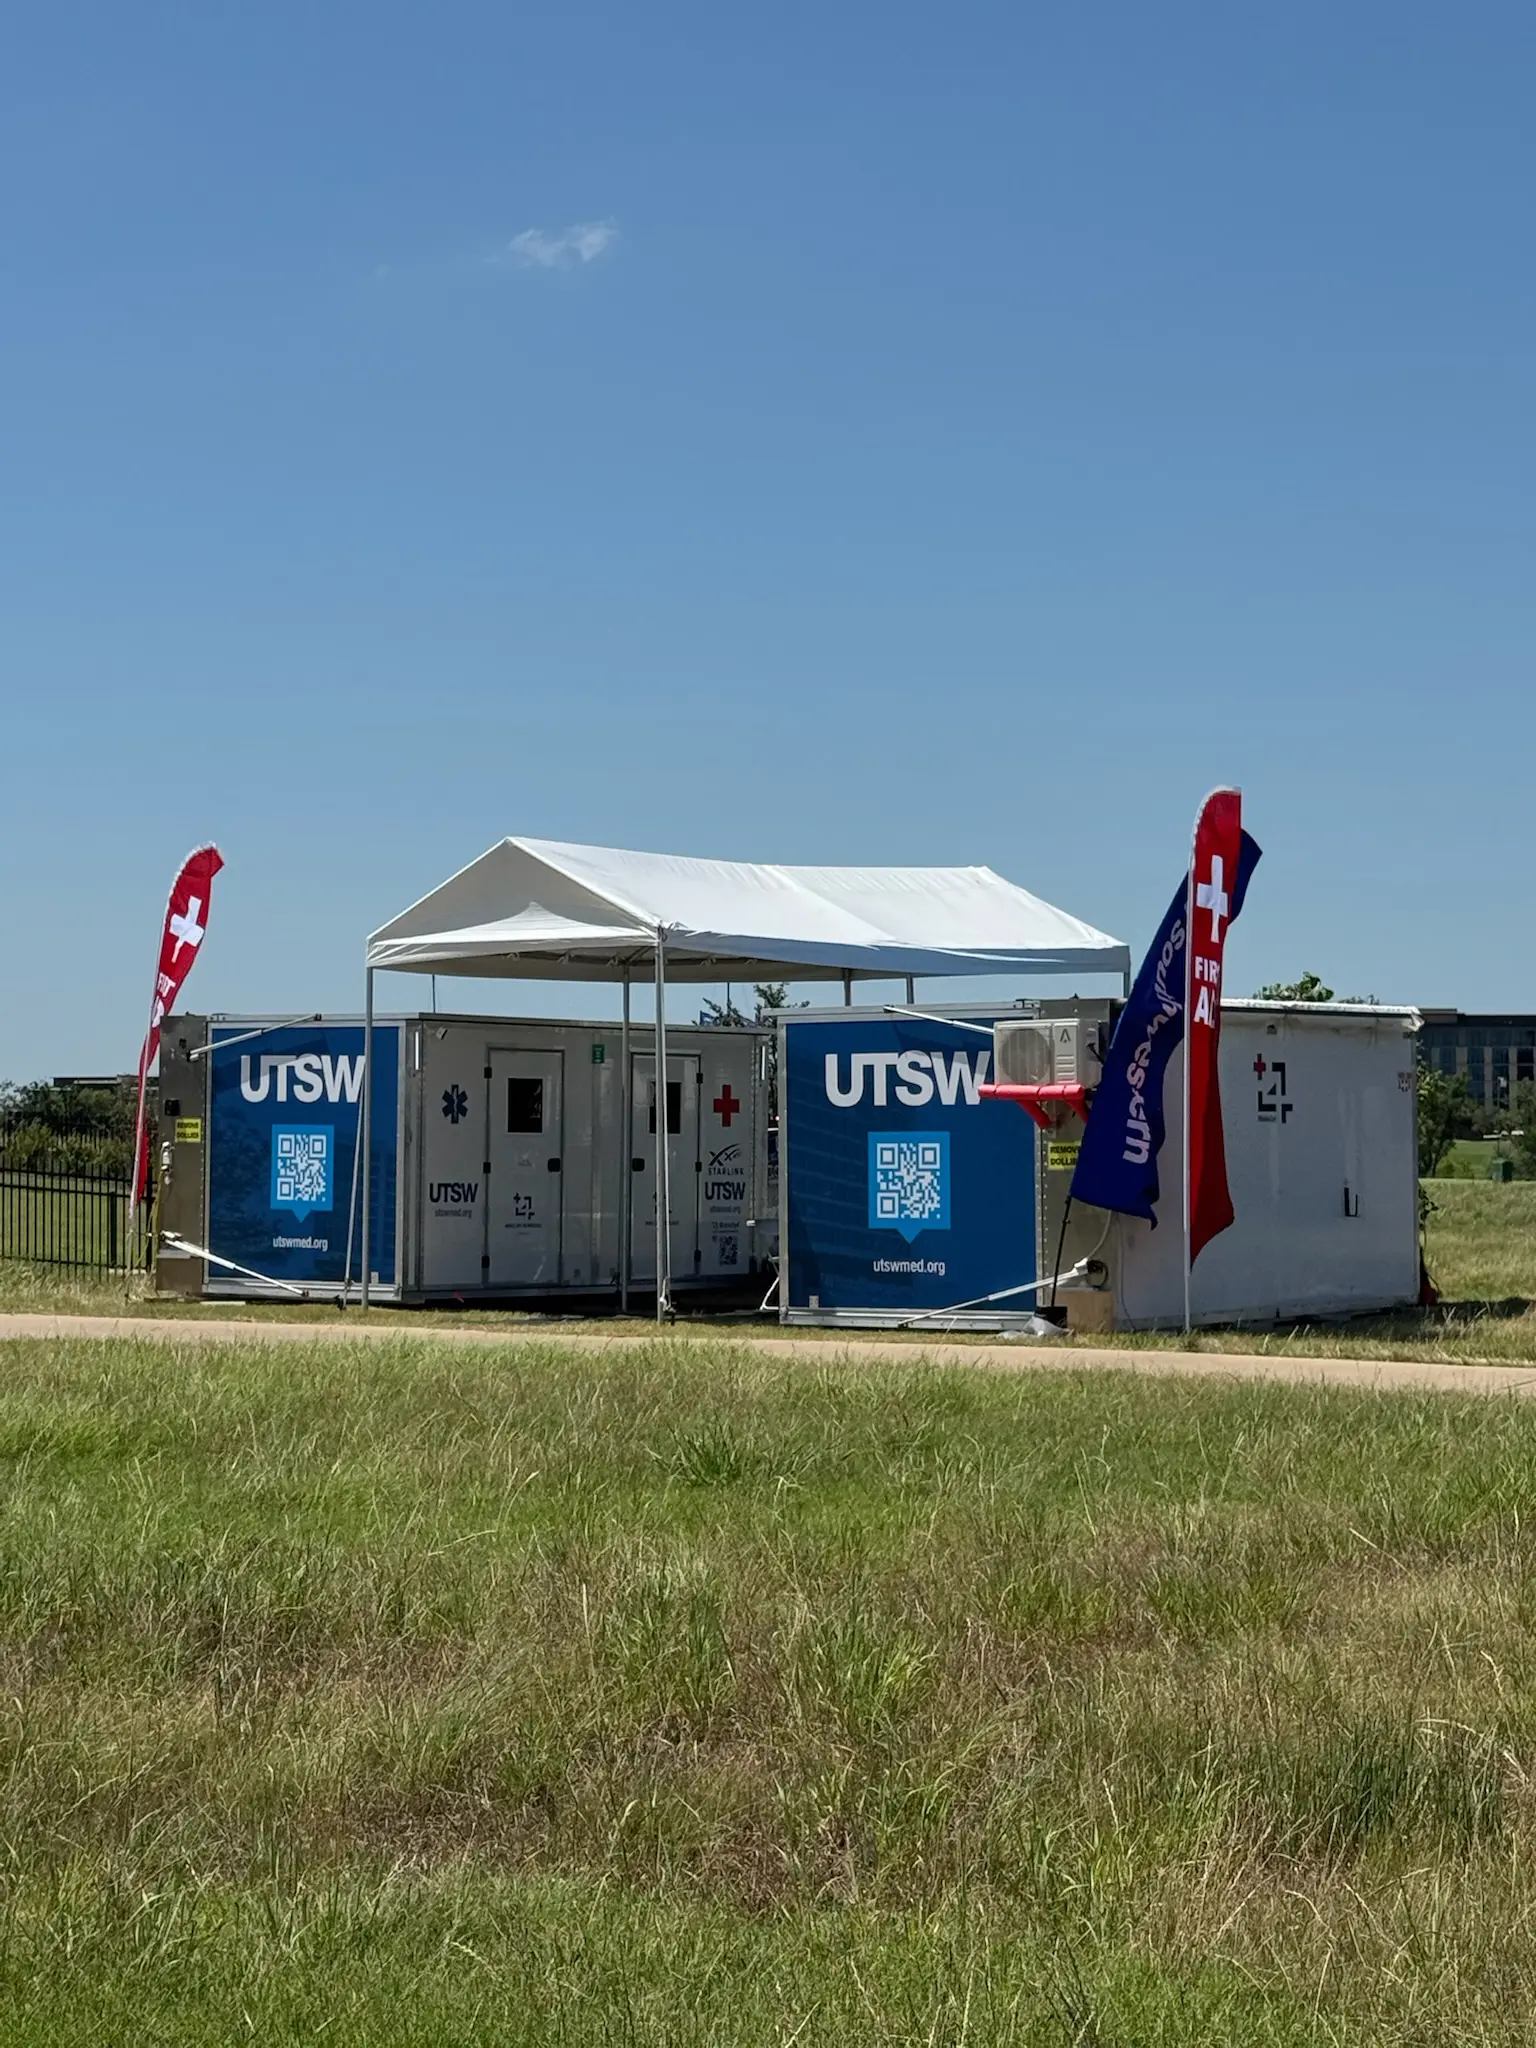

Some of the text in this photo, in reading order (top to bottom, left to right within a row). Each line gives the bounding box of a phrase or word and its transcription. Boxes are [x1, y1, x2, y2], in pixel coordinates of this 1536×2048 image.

[240, 1053, 366, 1103] UTSW
[825, 1050, 991, 1108] UTSW
[708, 1167, 745, 1176] STARLINK
[429, 1182, 479, 1204] UTSW
[704, 1181, 746, 1201] UTSW
[272, 1235, 329, 1251] utswmed.org
[873, 1258, 946, 1276] utswmed.org
